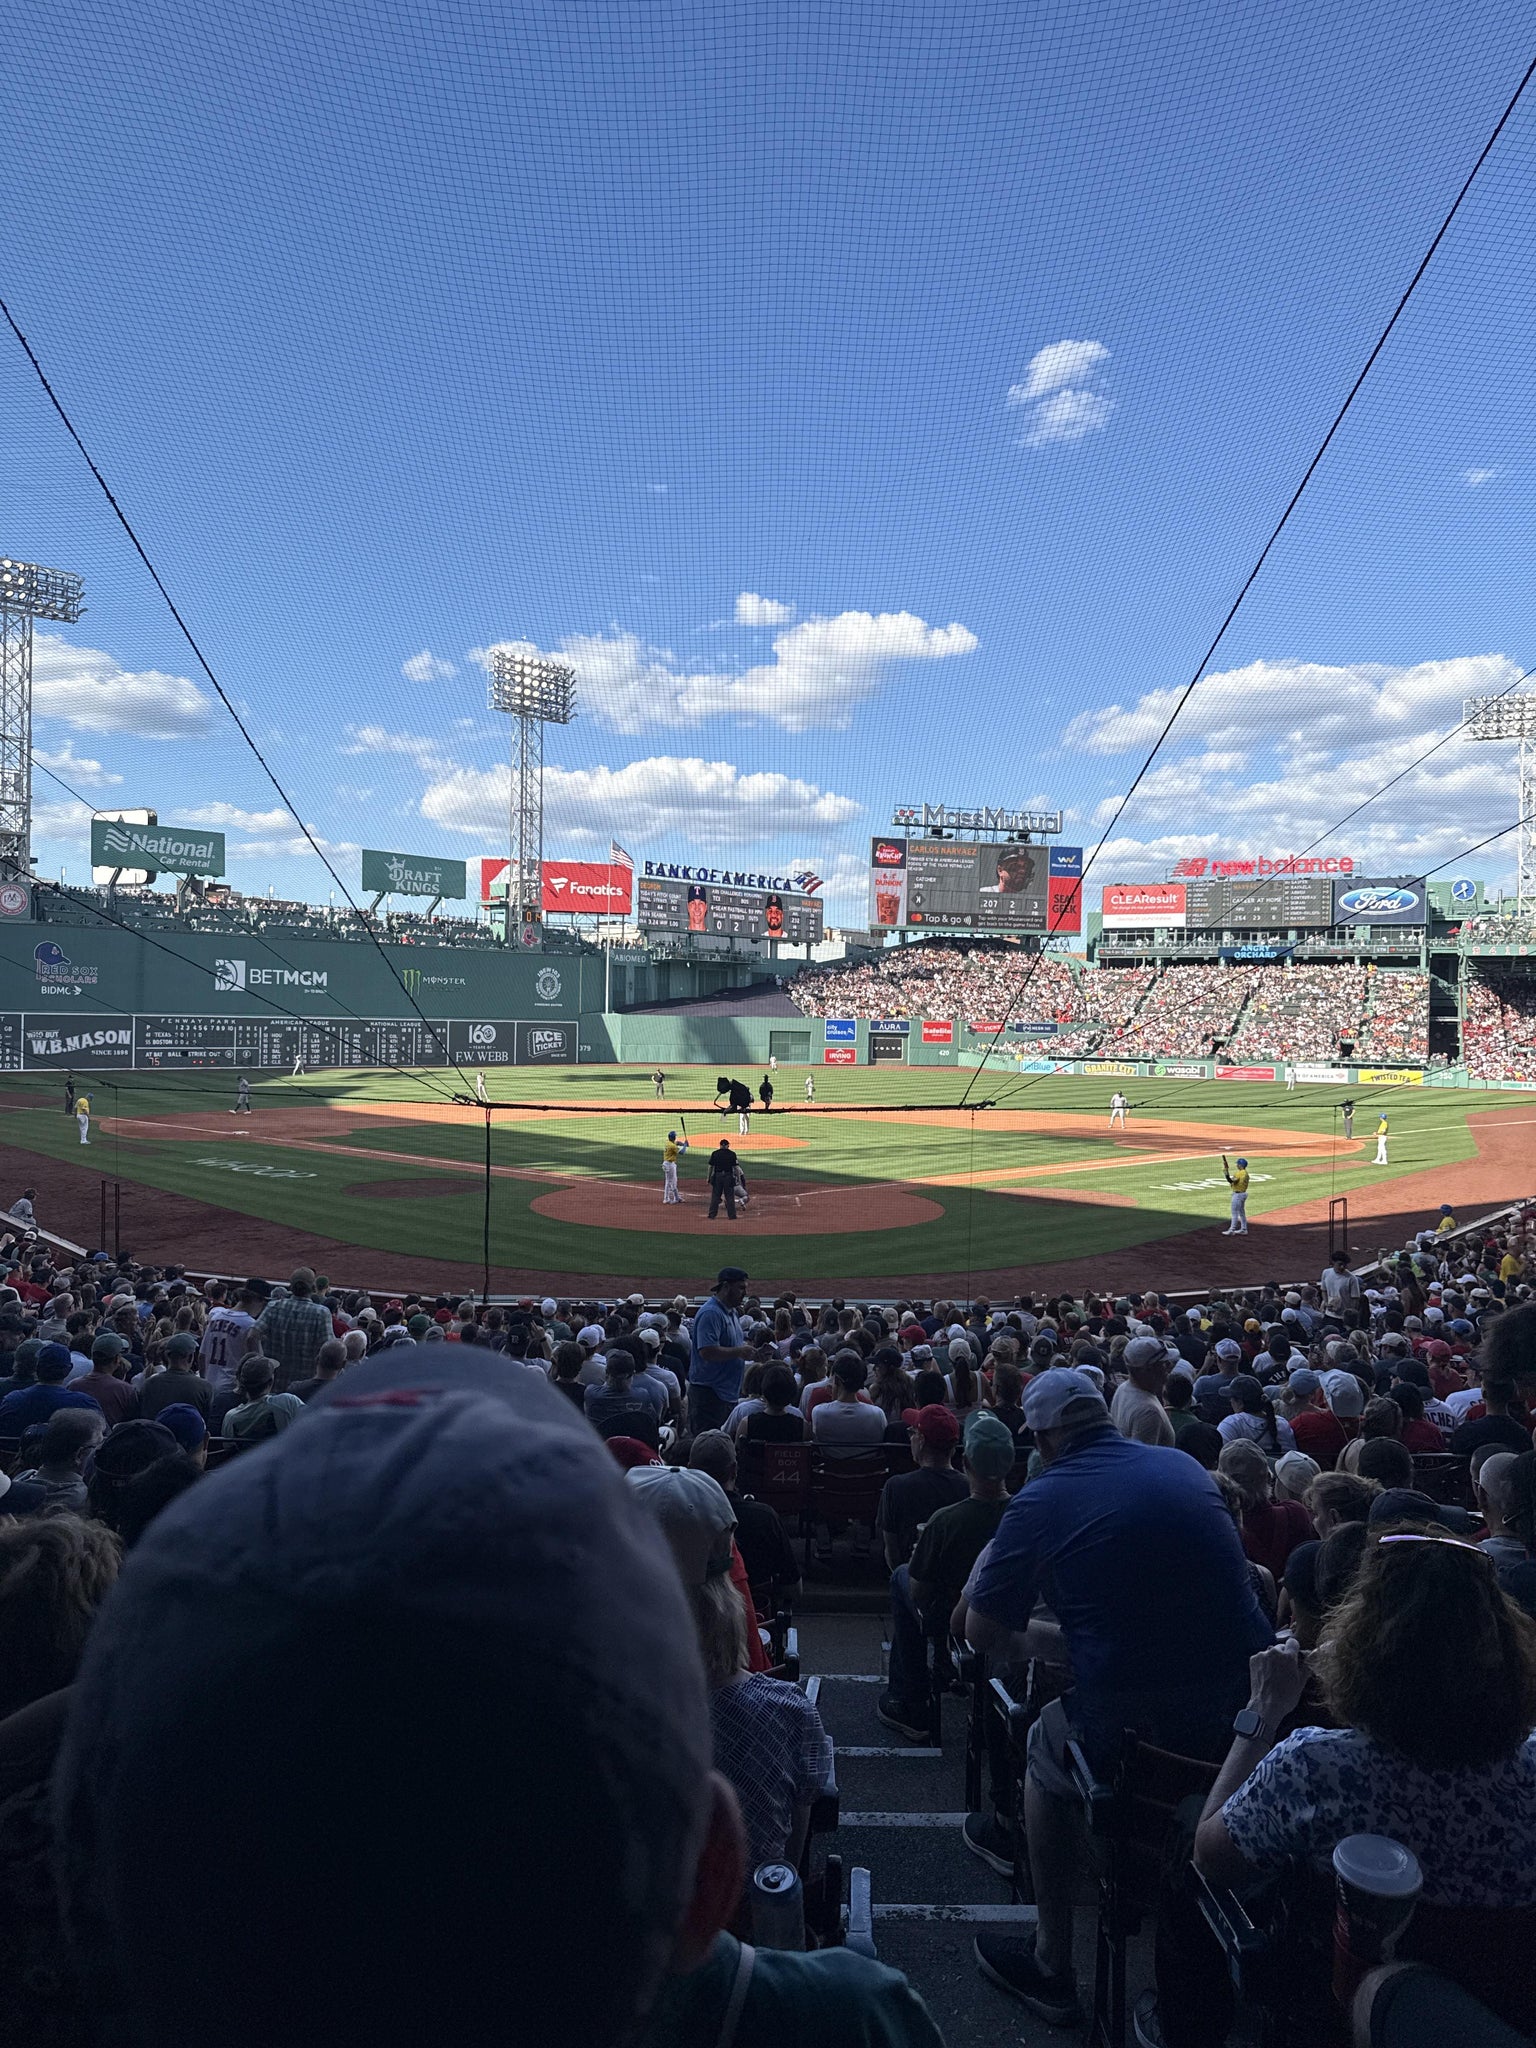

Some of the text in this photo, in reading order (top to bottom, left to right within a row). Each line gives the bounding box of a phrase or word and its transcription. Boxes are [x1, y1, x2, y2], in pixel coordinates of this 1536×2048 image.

[922, 802, 1064, 833] MassMutual
[160, 856, 210, 868] Car Rental
[1212, 854, 1354, 876] new balance
[389, 867, 442, 883] DRAFT
[644, 860, 792, 891] BANK OF AMERICA
[395, 880, 440, 894] KINGS
[570, 882, 623, 896] Fanatics
[1054, 894, 1075, 904] SEAT
[1111, 894, 1177, 904] CLEAResult
[1354, 891, 1401, 910] Ford
[1052, 904, 1076, 914] GEEK
[924, 914, 961, 925] Tap & go
[717, 921, 754, 932] 0 2 1
[615, 955, 646, 963] ABIOMED
[41, 965, 98, 976] RED SOX
[41, 974, 97, 984] SCHOLARS
[250, 969, 327, 986] BETMGM
[423, 976, 466, 986] MONSTER
[41, 986, 71, 995] BIDMC
[469, 1025, 496, 1044] 160
[535, 1031, 562, 1042] ACE
[536, 1042, 562, 1051] TICKET
[149, 1058, 160, 1066] 75
[456, 1052, 509, 1062] F.W. WEBB
[1024, 1063, 1051, 1071] jetBlue
[1084, 1064, 1136, 1074] GRANITE CITY
[1167, 1066, 1200, 1074] wasabi
[1371, 1074, 1410, 1083] TWISTED TEA
[210, 1337, 227, 1366] 11
[772, 1470, 800, 1484] 44
